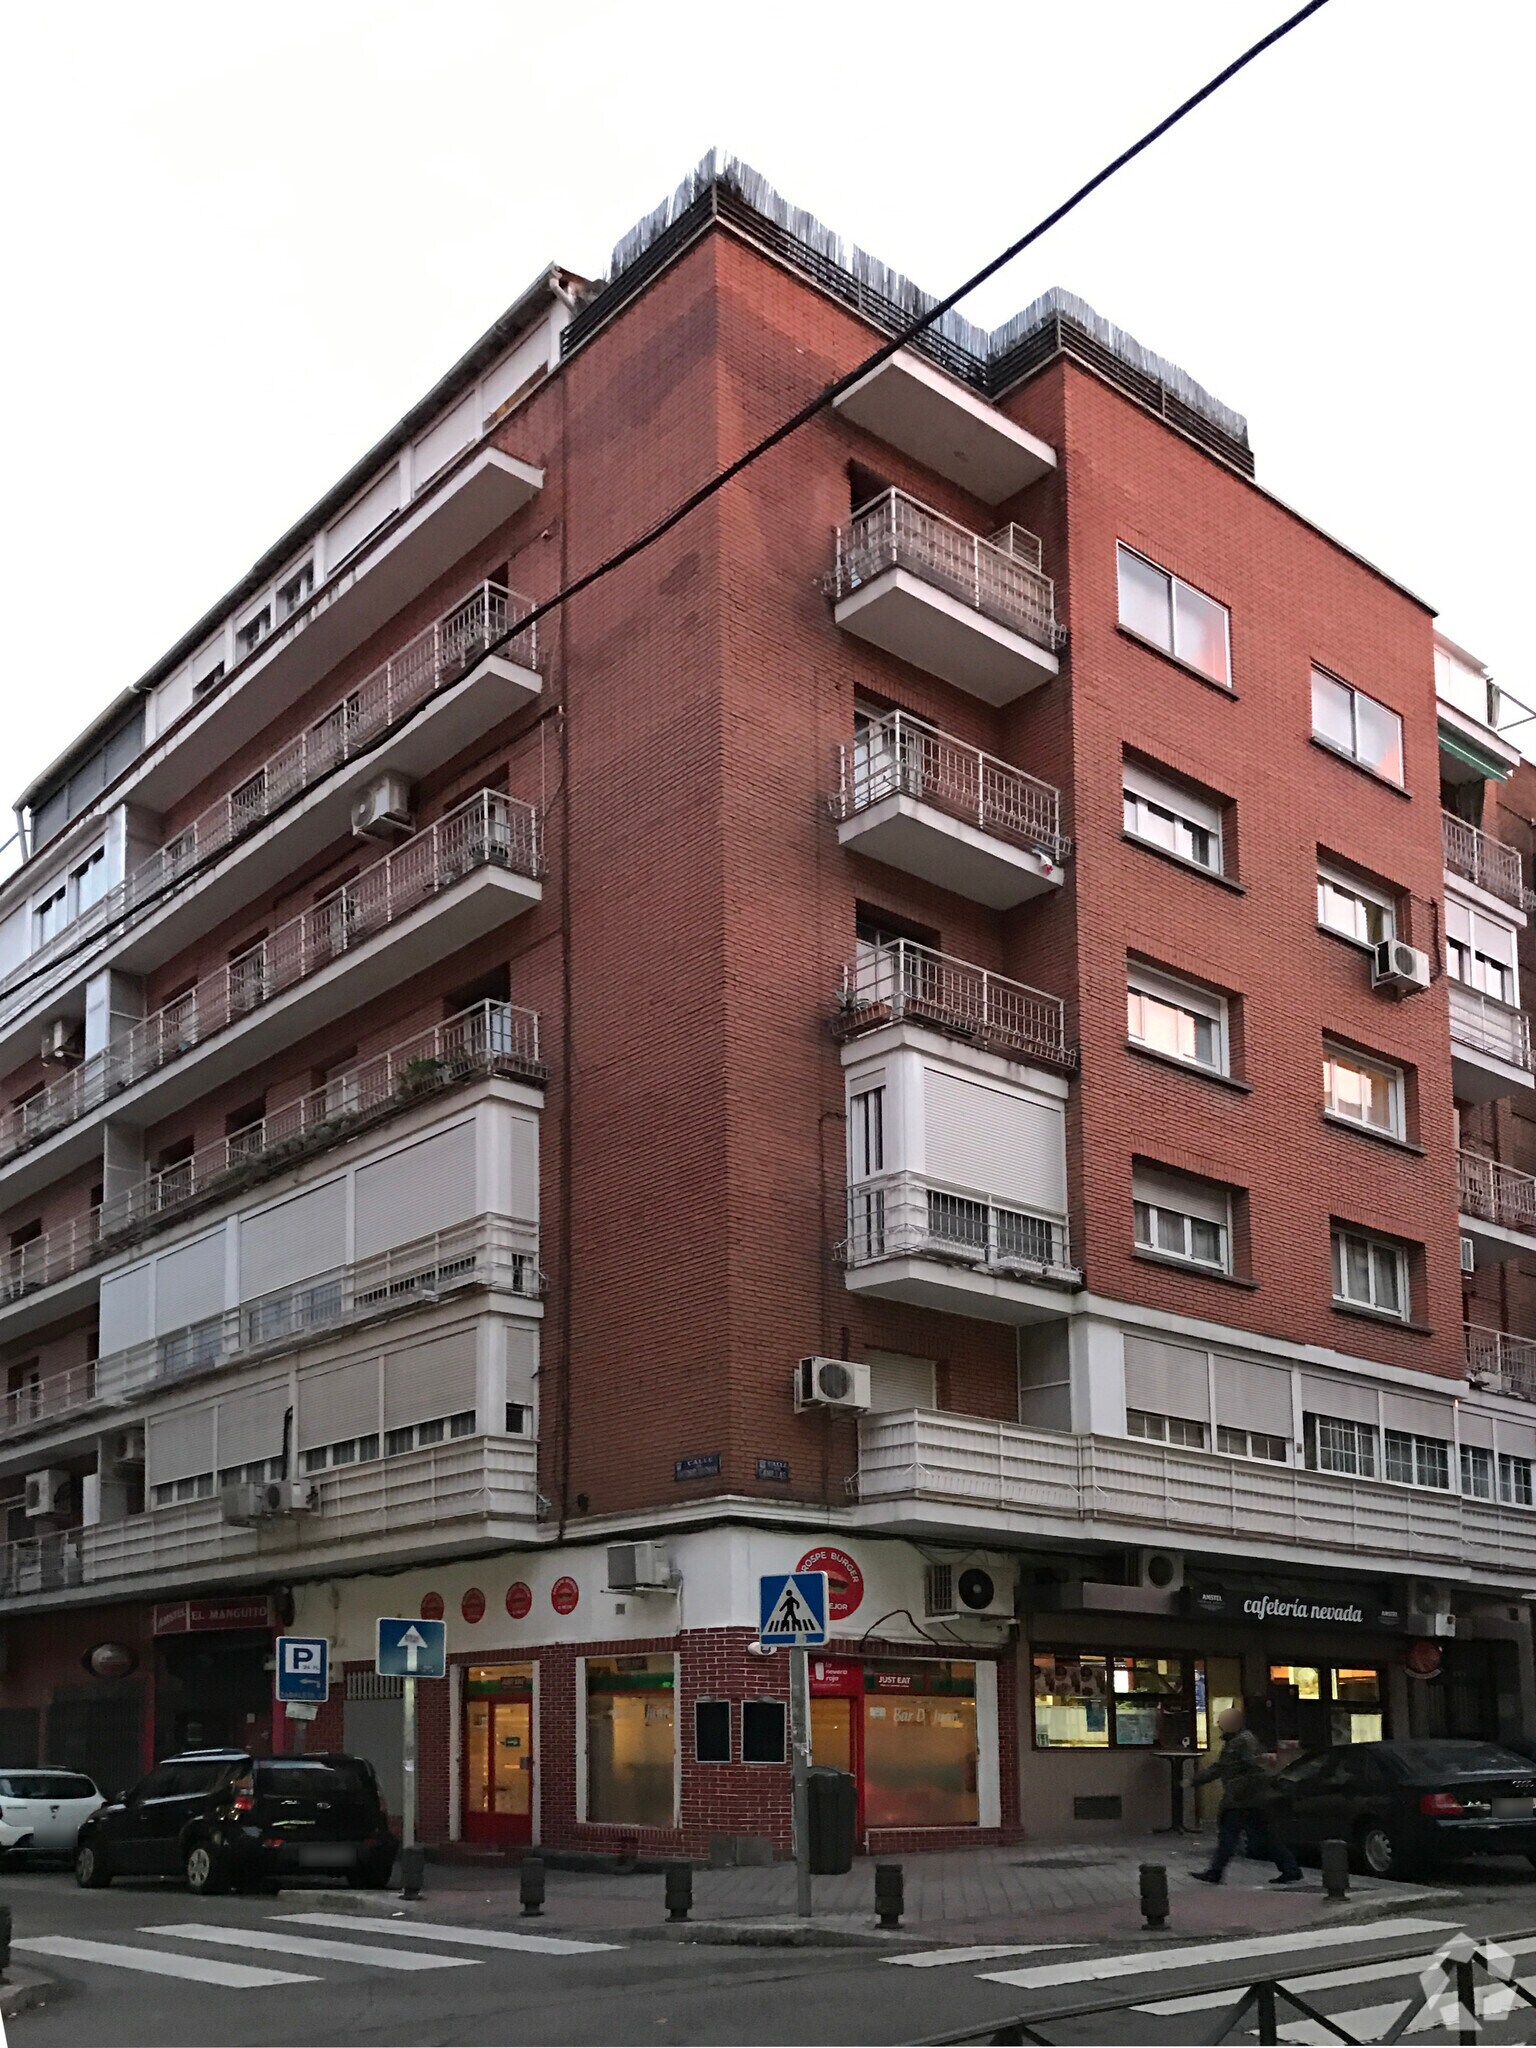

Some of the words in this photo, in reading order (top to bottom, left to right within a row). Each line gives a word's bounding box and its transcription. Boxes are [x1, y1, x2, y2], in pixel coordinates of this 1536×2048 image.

[687, 1457, 713, 1466] CALLE
[801, 1551, 827, 1573] ROSPE
[830, 1552, 860, 1583] BURGER
[191, 1610, 205, 1621] EL
[209, 1606, 267, 1620] MANGUITO
[829, 1602, 848, 1611] EJOR
[1243, 1595, 1308, 1620] cafetería
[1310, 1604, 1363, 1623] nevada
[293, 1647, 314, 1670] P
[878, 1676, 896, 1684] JUST
[893, 1707, 914, 1723] Bar
